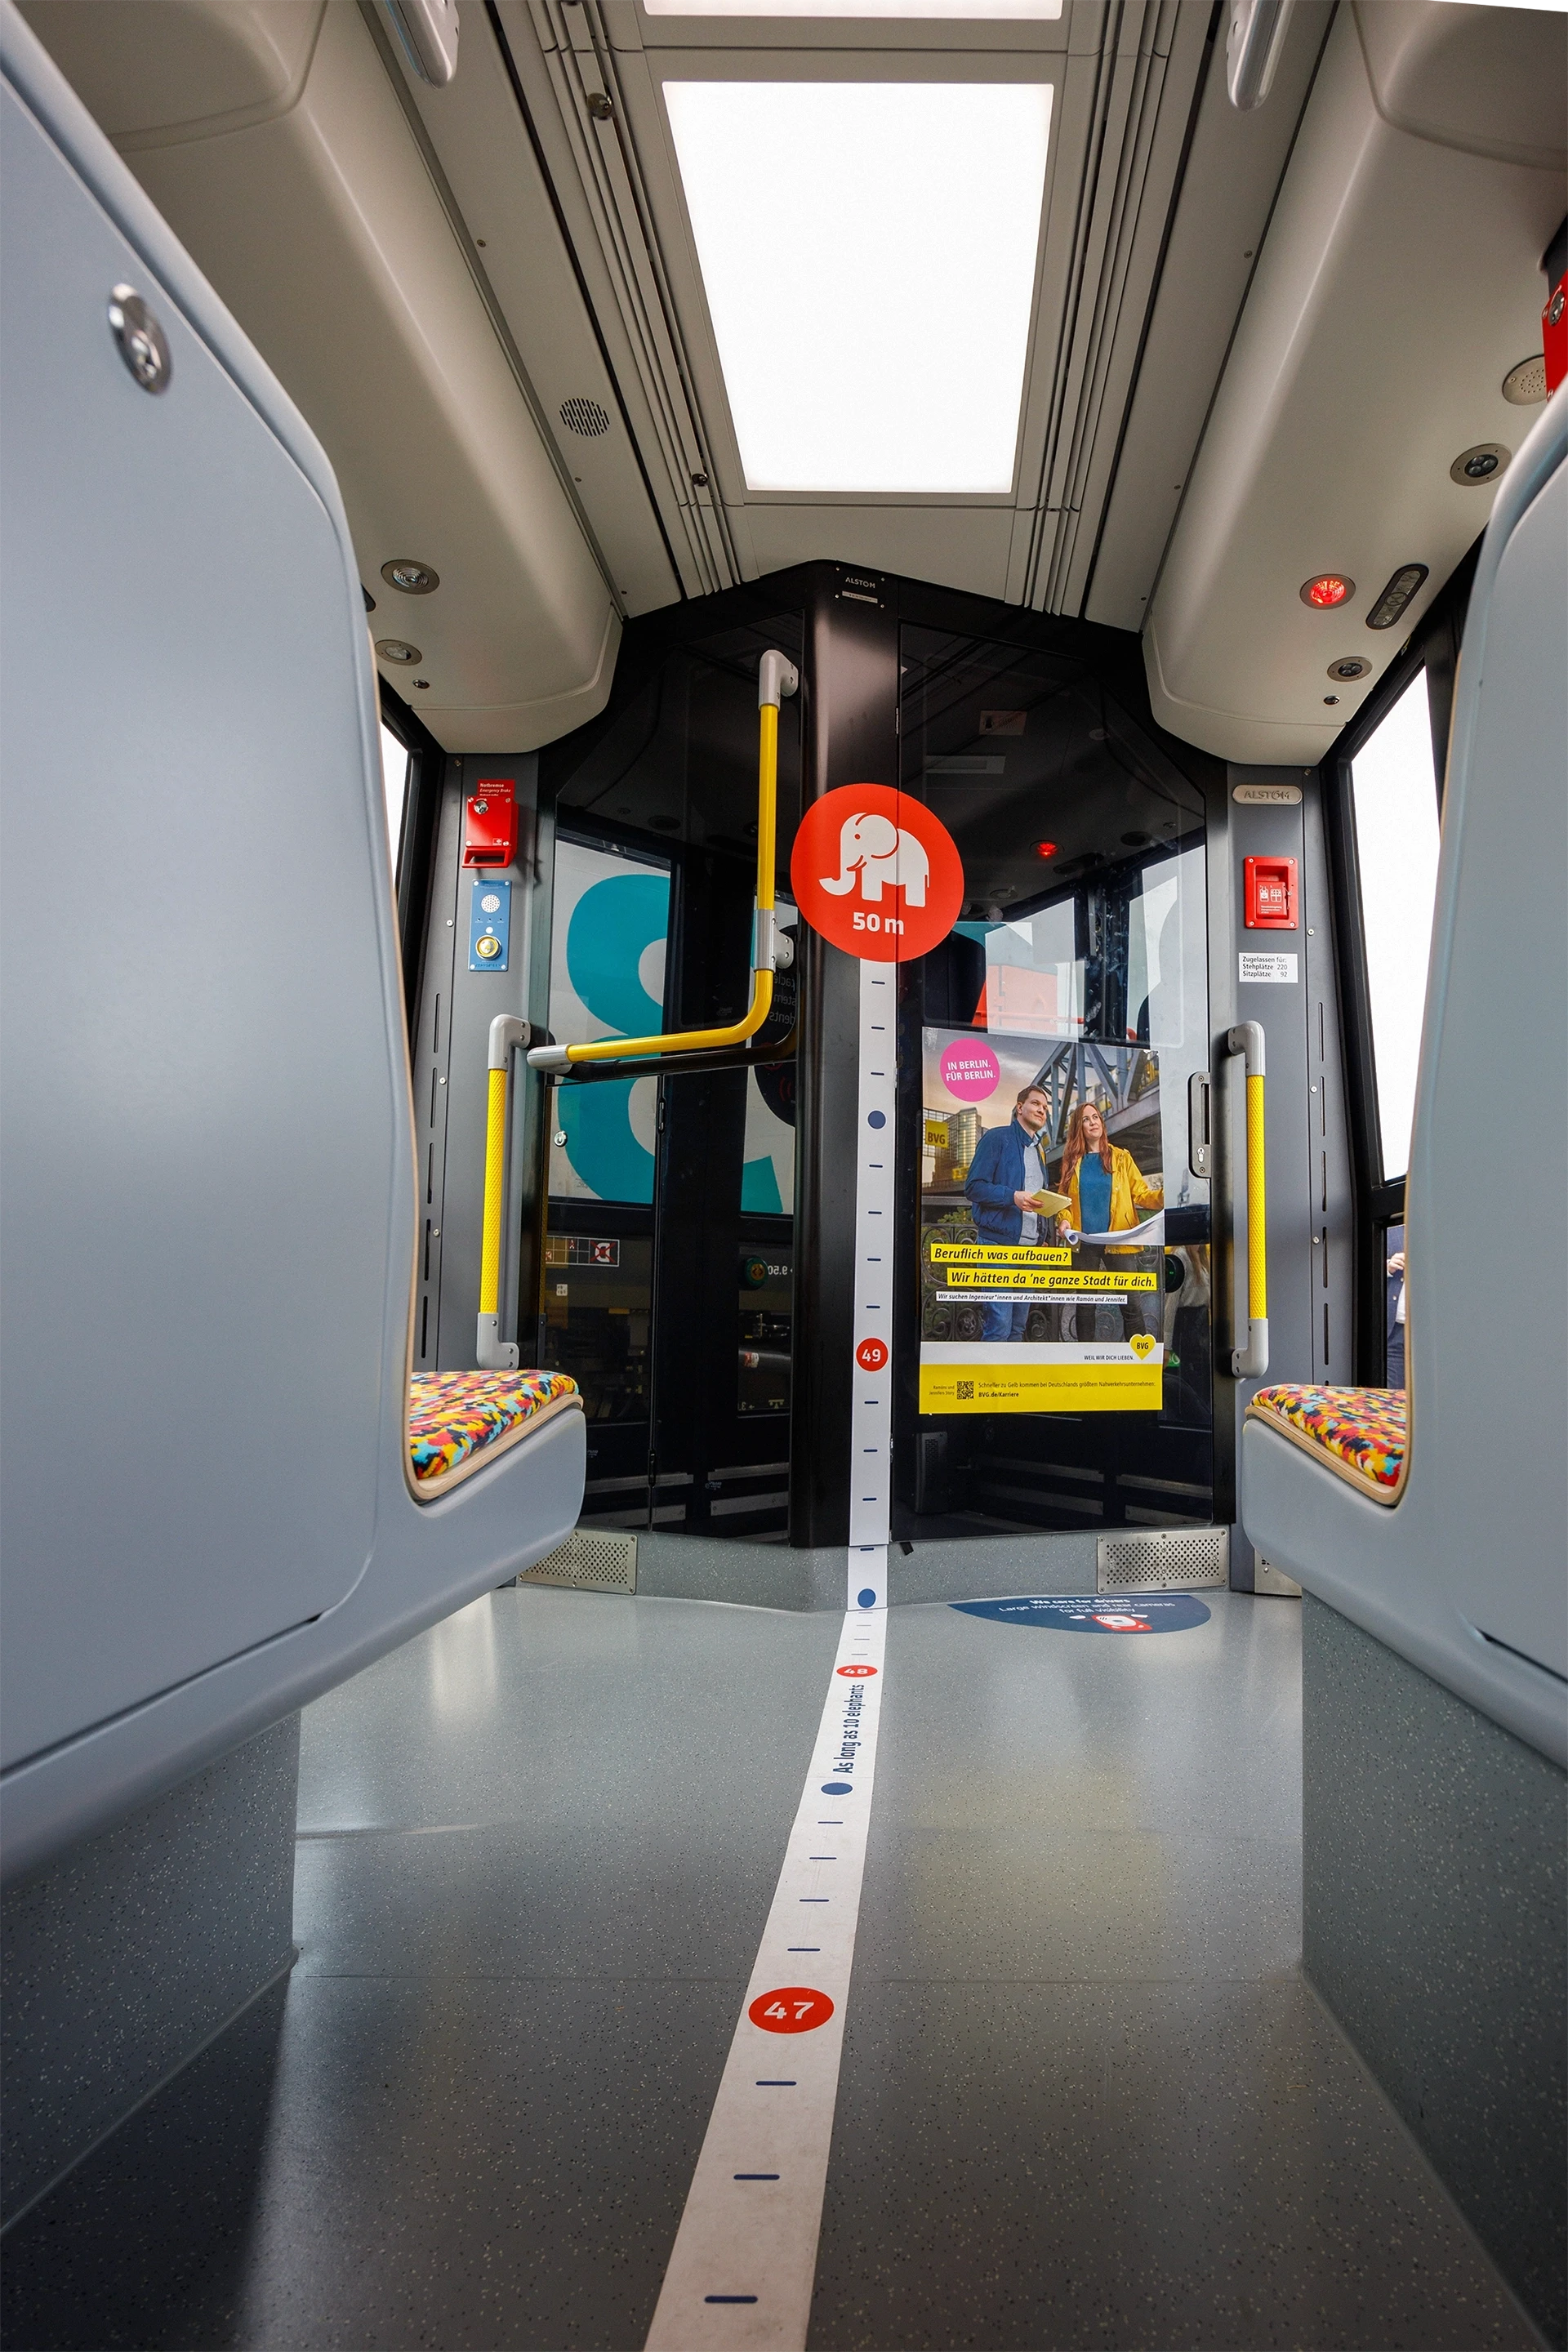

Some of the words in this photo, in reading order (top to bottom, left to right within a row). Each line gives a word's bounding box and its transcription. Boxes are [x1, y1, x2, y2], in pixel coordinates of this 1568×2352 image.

[845, 577, 875, 588] ALSTOM
[1244, 791, 1290, 800] ALSTOM
[853, 911, 880, 932] 50
[884, 917, 904, 935] m
[947, 1062, 957, 1071] IN
[959, 1059, 991, 1070] BERLIN.
[946, 1071, 963, 1081] FÜR
[964, 1070, 996, 1080] BERLIN.
[927, 1131, 946, 1145] BVG
[934, 1248, 983, 1259] Beruflich
[987, 1252, 1009, 1260] was
[1011, 1250, 1068, 1262] aufbauen?
[951, 1272, 970, 1283] Wir
[973, 1272, 1009, 1284] hätten
[1013, 1273, 1027, 1284] da
[1049, 1276, 1080, 1287] ganze
[1083, 1275, 1111, 1286] Stadt
[1114, 1276, 1129, 1287] für
[1131, 1276, 1154, 1287] dich.
[1136, 1342, 1149, 1350] BVG
[862, 1348, 881, 1362] 49
[842, 1684, 866, 1717] elephants
[843, 1718, 859, 1728] 10
[844, 1731, 858, 1740] as
[833, 1741, 862, 1759] long
[833, 1762, 853, 1774] As
[764, 2002, 815, 2020] 47
